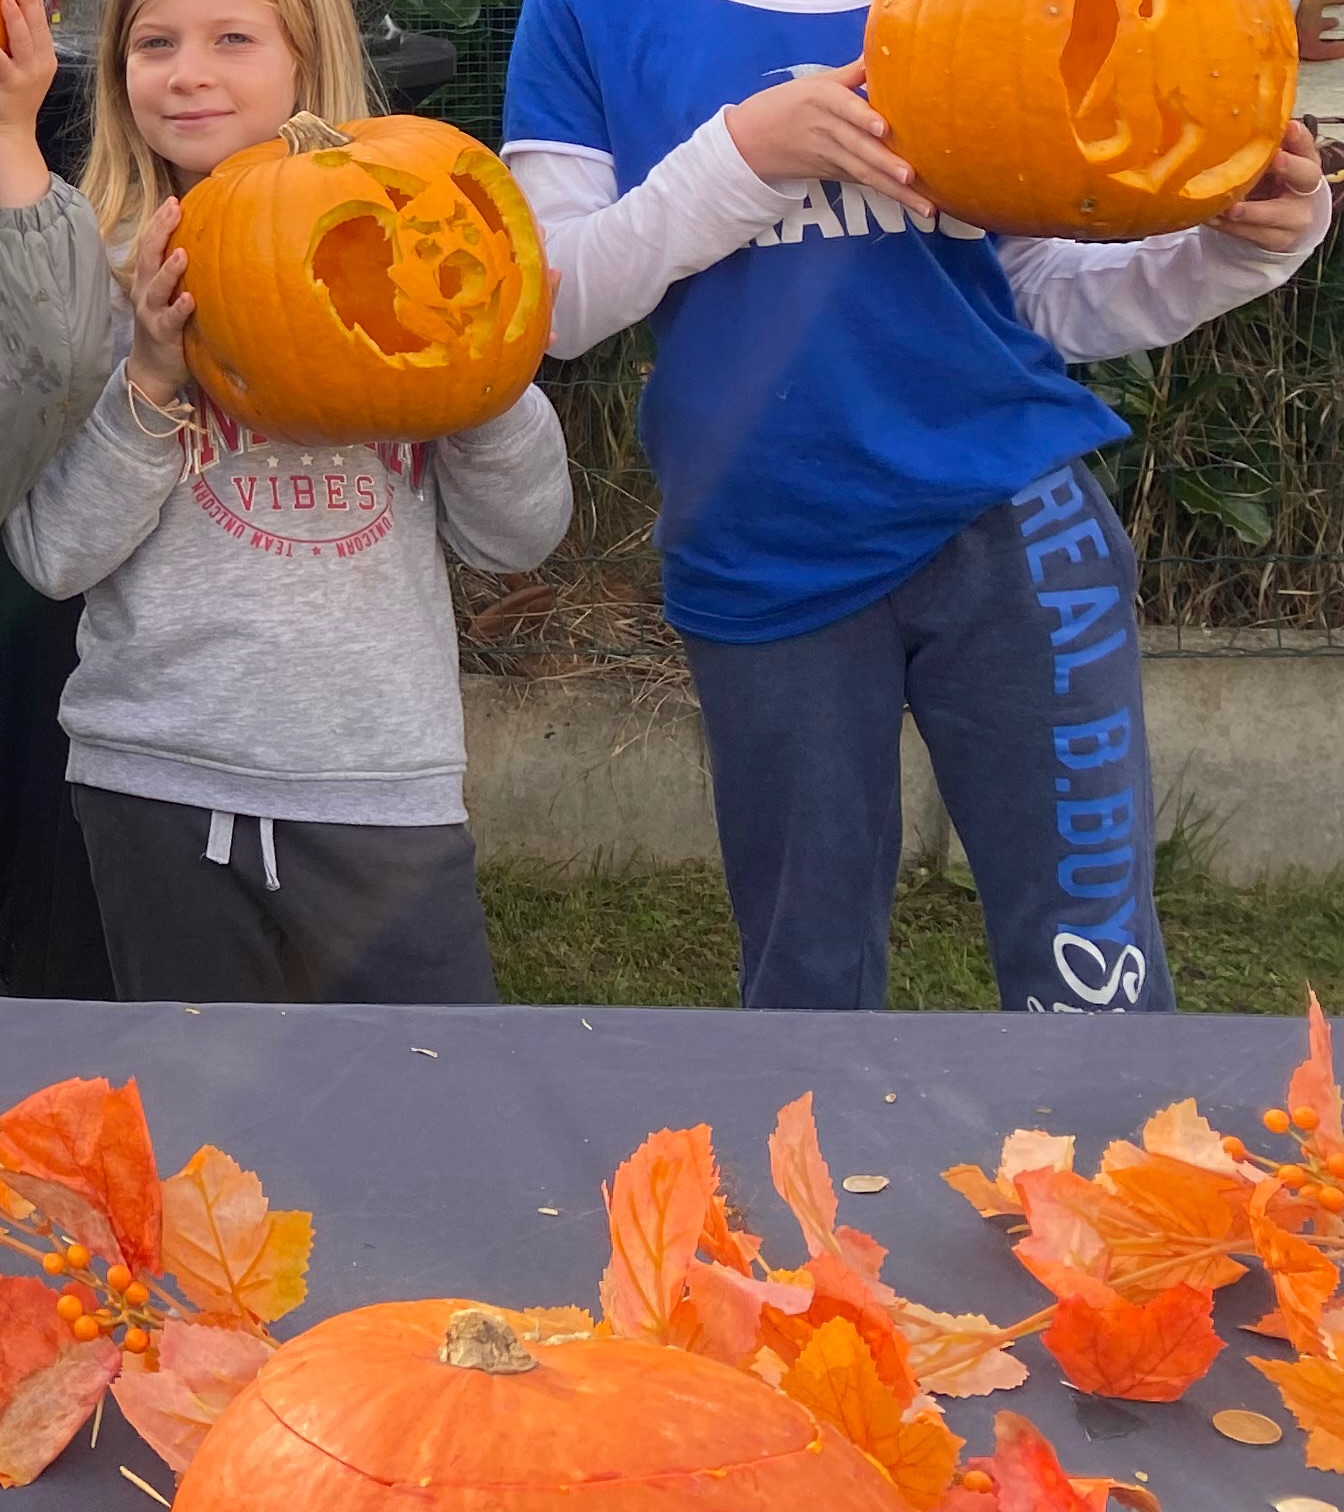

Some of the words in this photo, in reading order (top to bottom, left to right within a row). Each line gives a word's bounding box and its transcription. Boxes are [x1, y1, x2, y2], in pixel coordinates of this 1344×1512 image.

[191, 480, 245, 538] UNICORN
[231, 474, 376, 512] VIBES
[250, 531, 293, 557] TEAM
[336, 516, 393, 558] UNICORN
[1012, 466, 1127, 694] REAL
